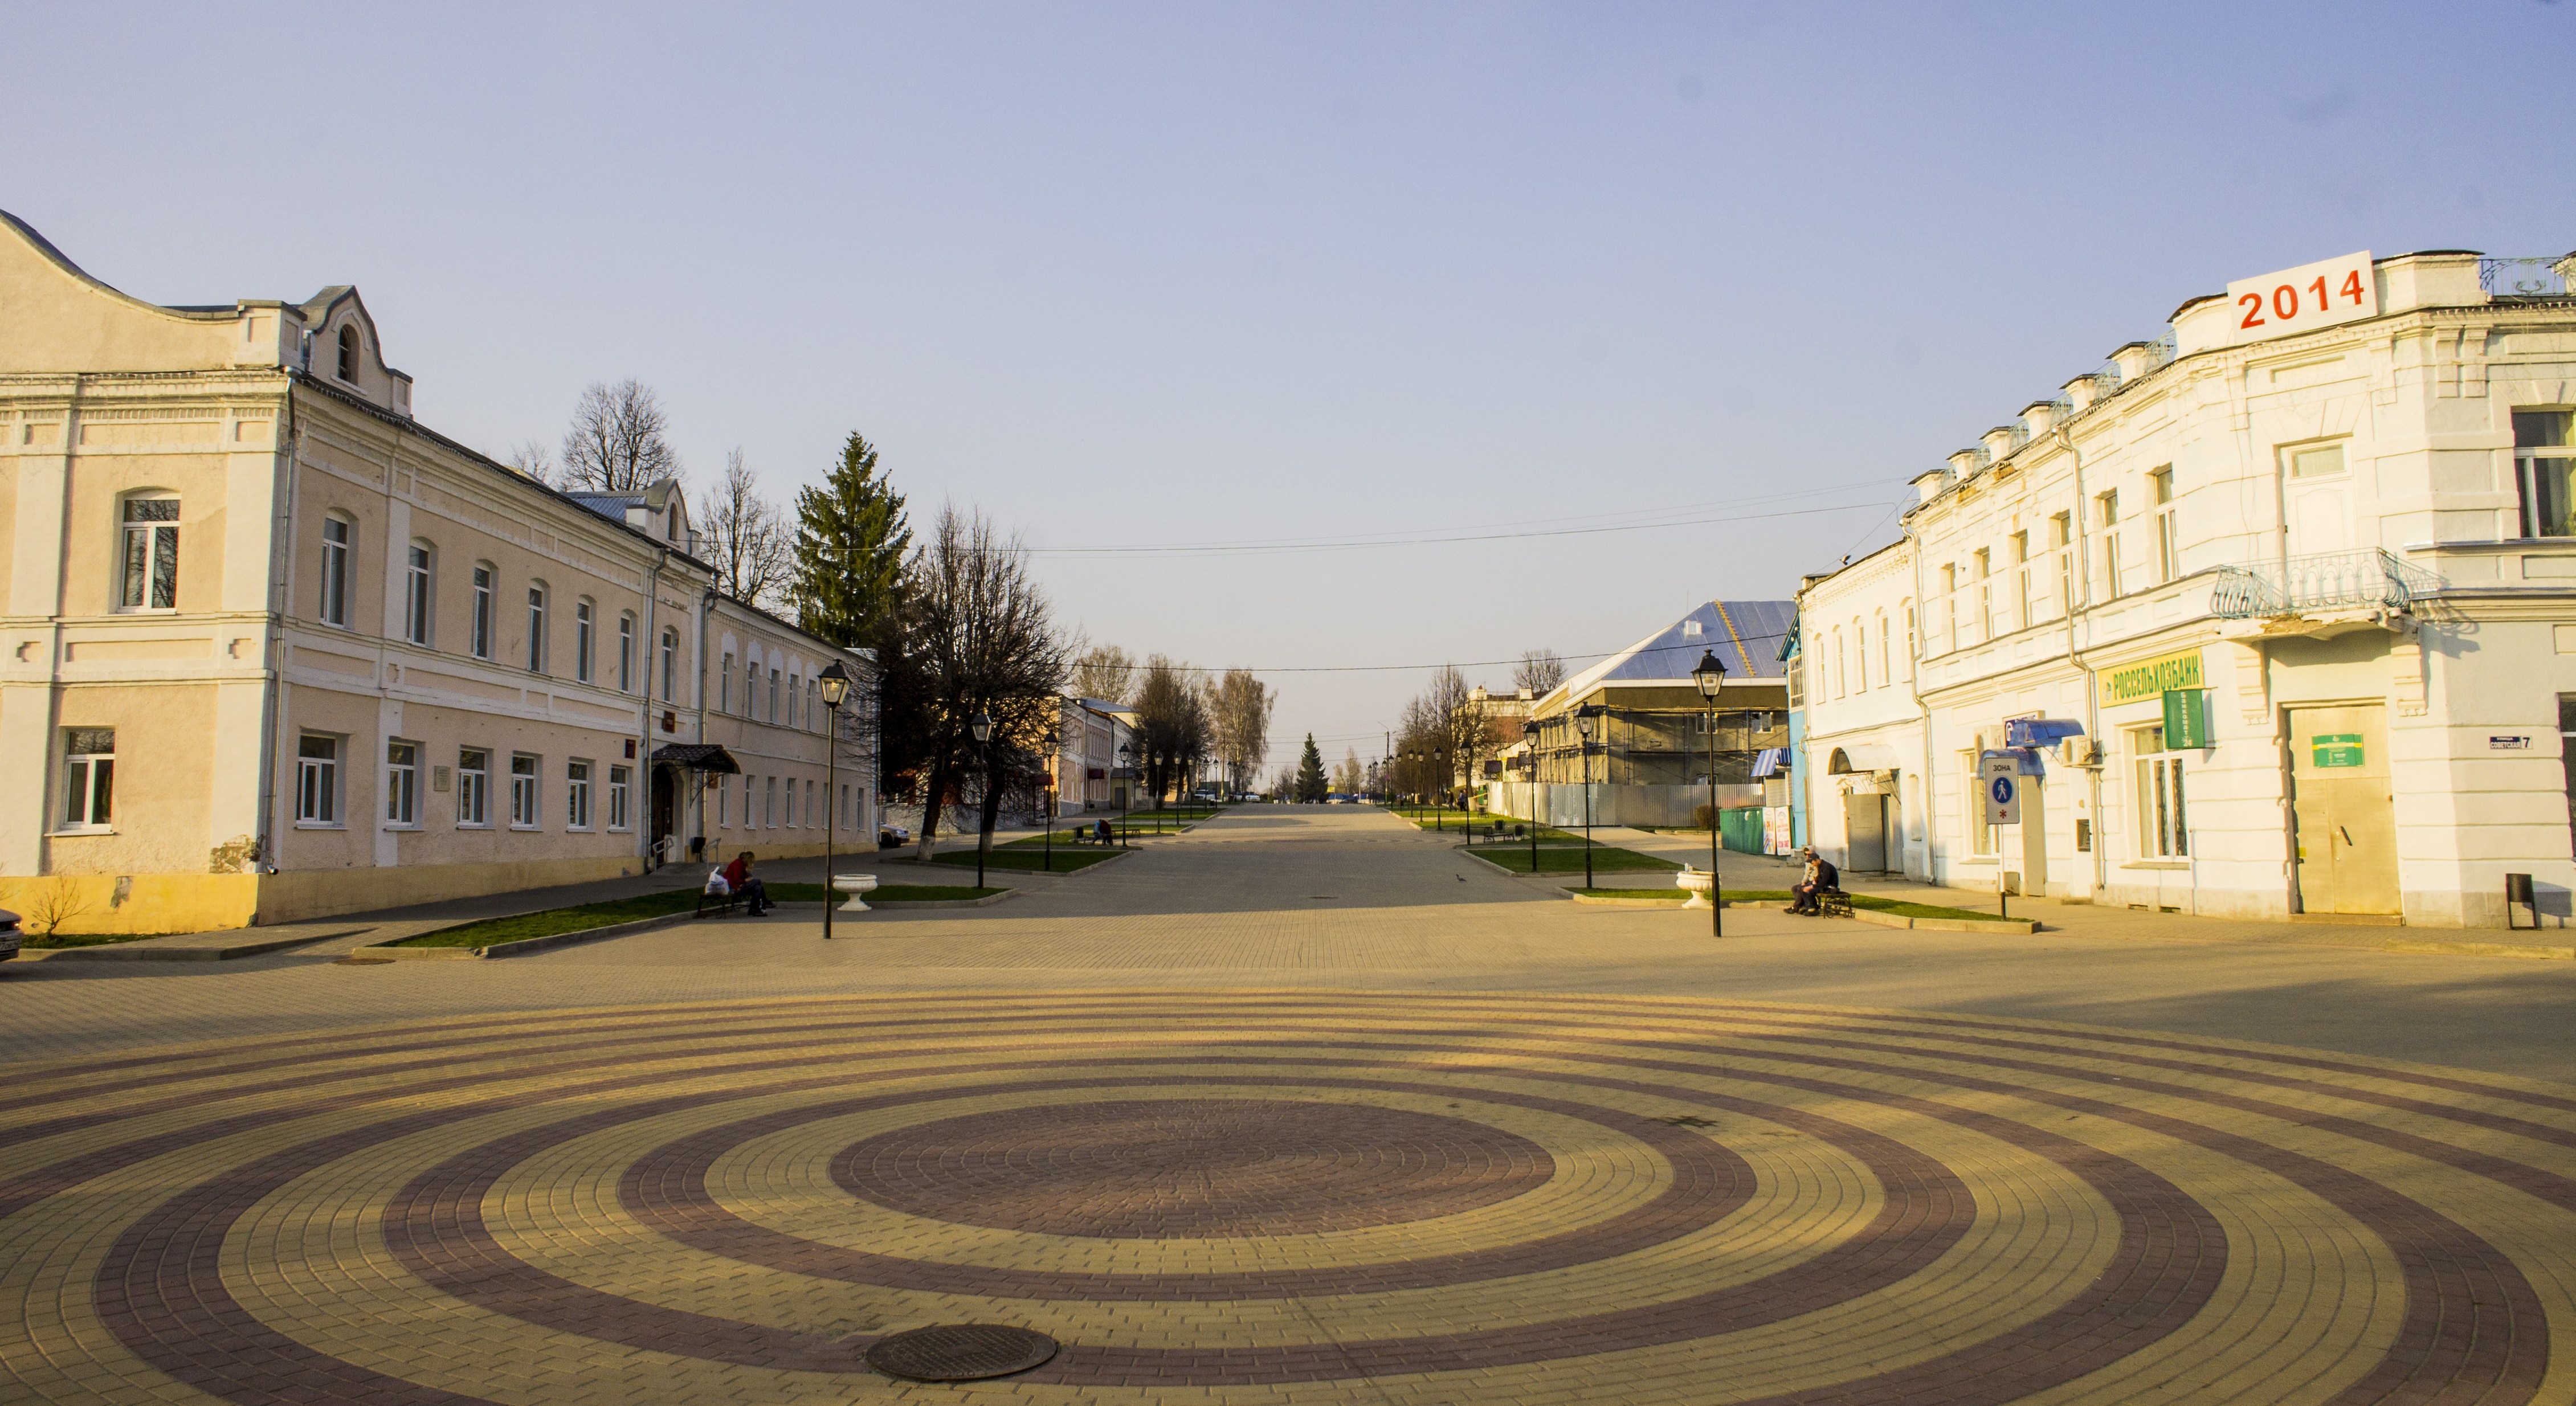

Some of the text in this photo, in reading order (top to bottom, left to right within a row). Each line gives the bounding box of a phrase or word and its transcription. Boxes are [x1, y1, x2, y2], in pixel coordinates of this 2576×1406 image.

[2238, 269, 2364, 329] 2014
[2113, 655, 2199, 700] РОССЕЛЬХОЗБАНК
[2522, 737, 2530, 748] 7
